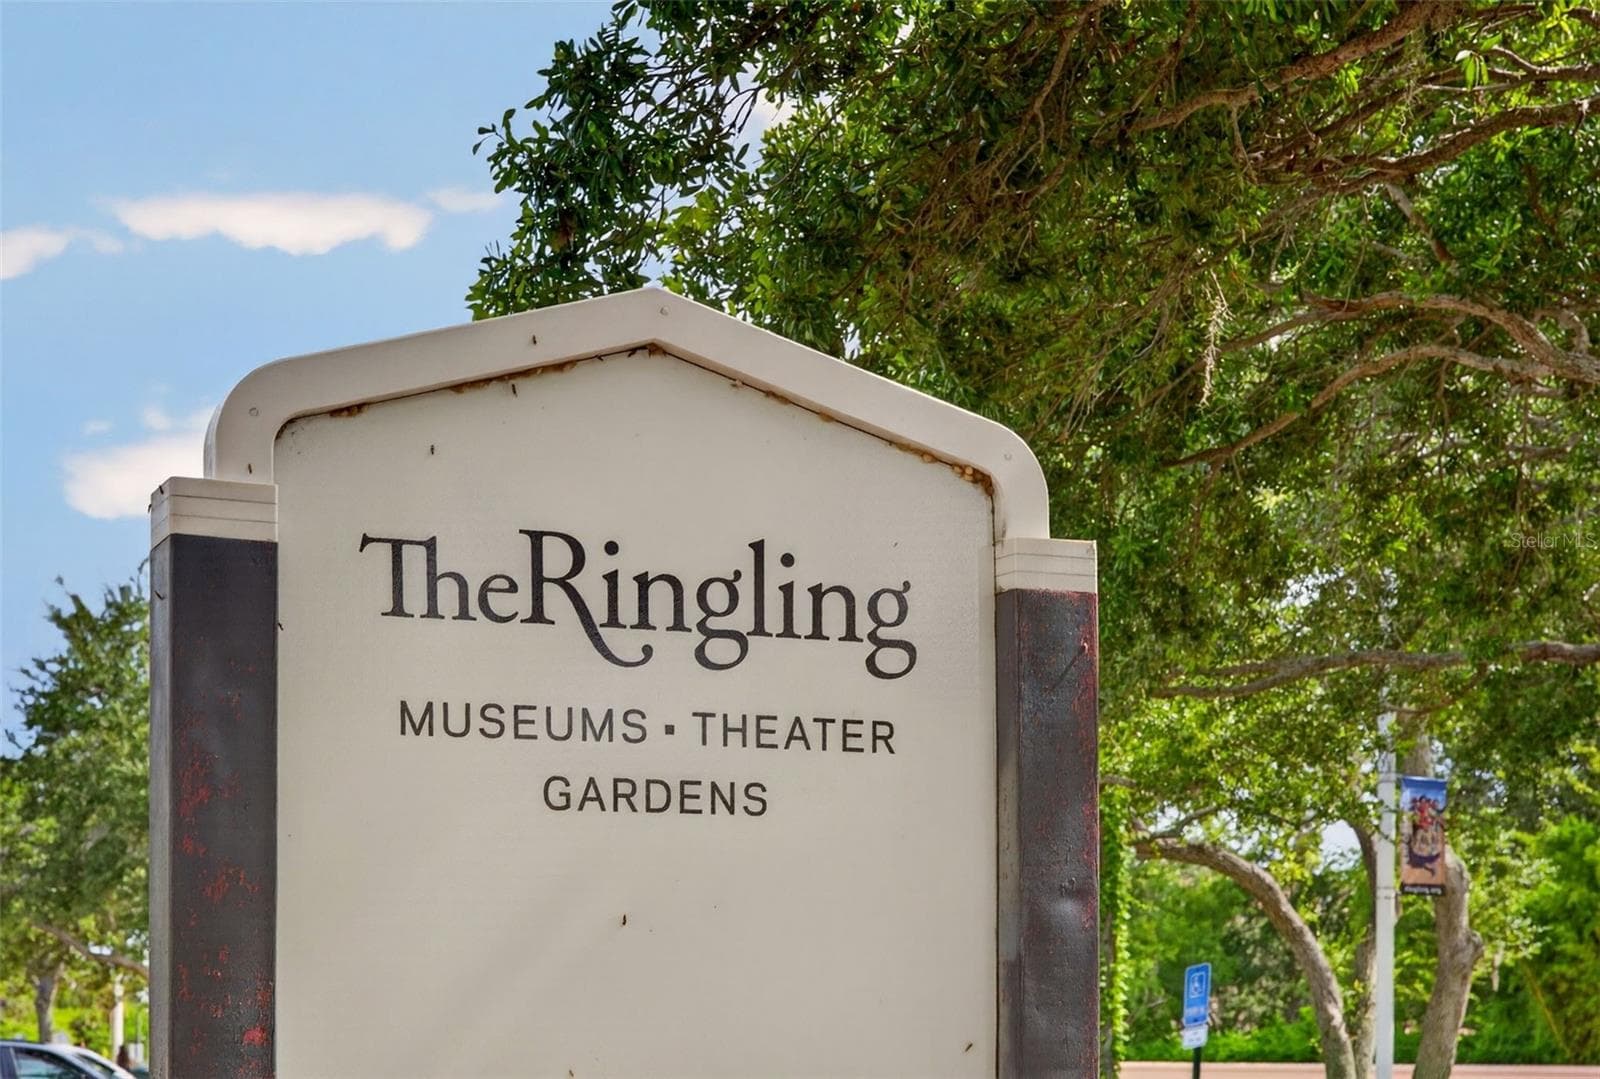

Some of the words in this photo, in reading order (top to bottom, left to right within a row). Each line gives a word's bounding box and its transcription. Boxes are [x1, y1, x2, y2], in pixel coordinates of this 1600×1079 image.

[400, 701, 646, 743] MUSEUMS
[692, 712, 895, 754] THEATER
[544, 776, 767, 816] GARDENS
